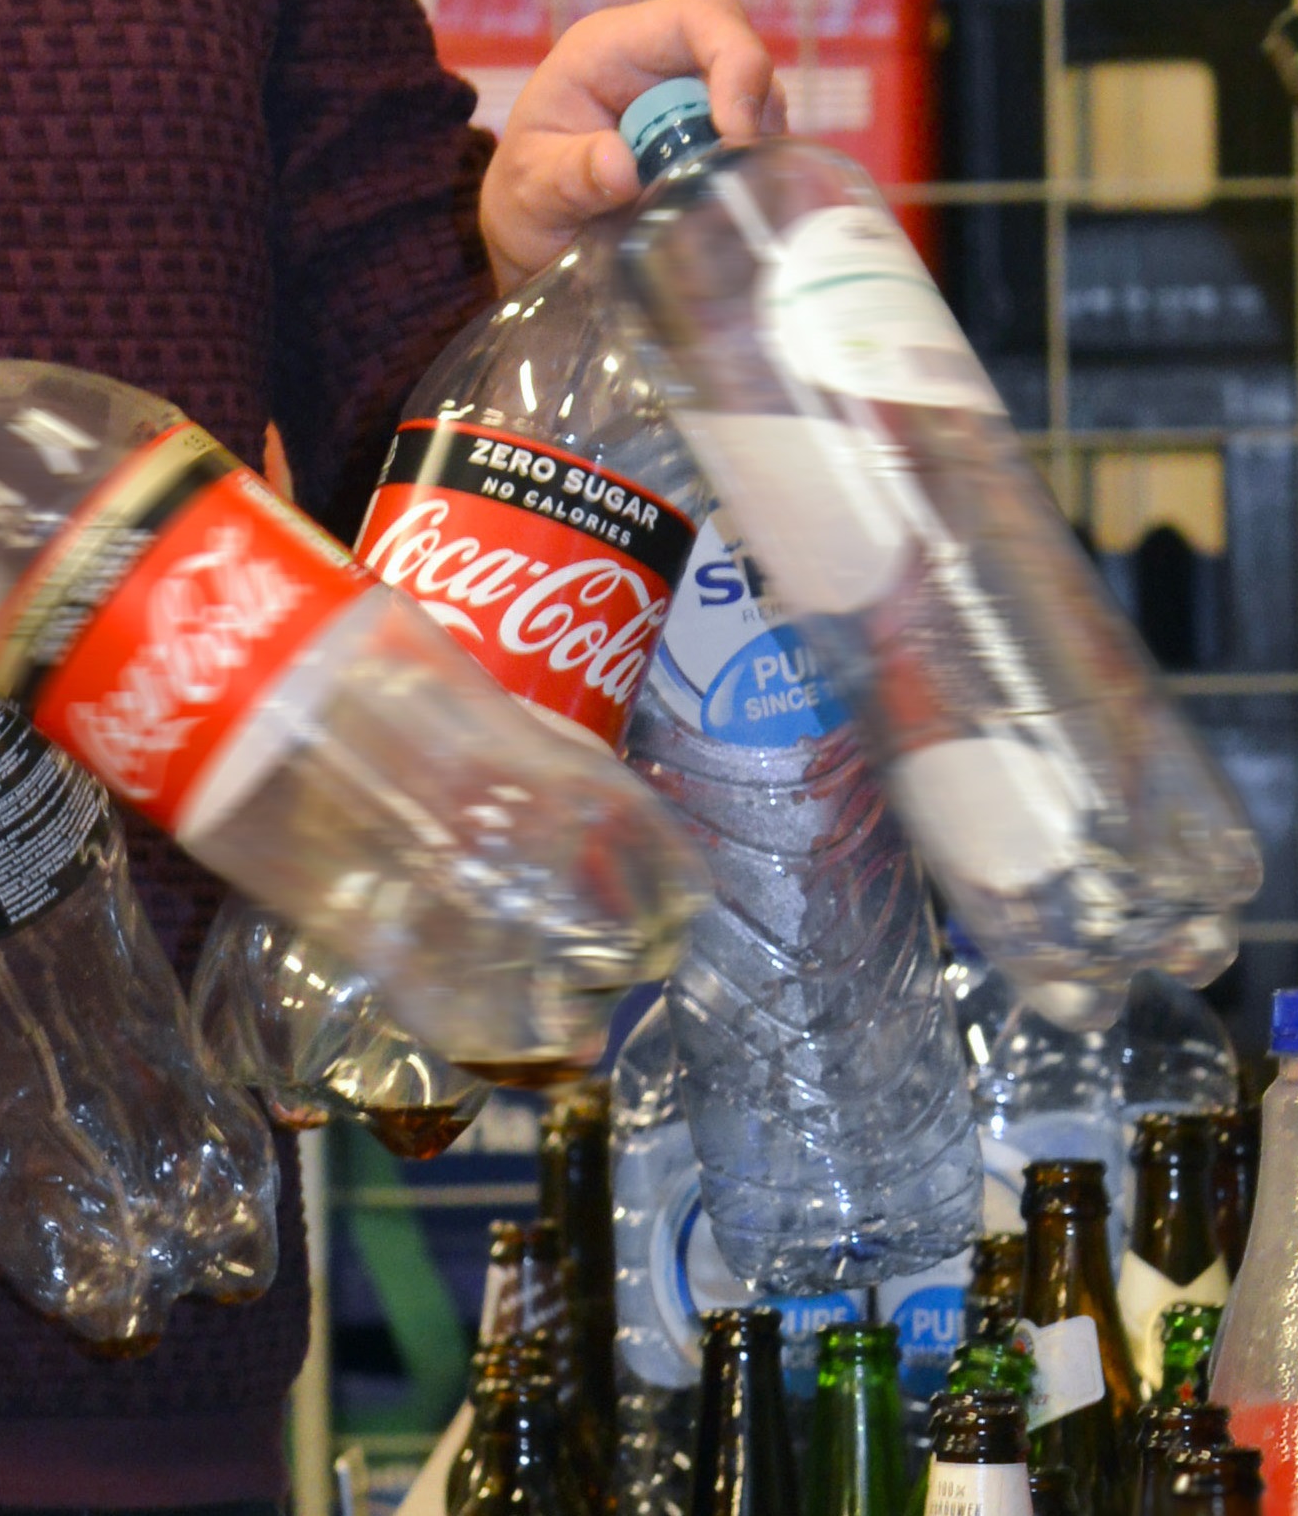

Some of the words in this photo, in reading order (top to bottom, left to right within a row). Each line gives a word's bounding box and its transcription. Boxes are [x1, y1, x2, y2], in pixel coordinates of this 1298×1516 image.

[468, 438, 557, 482] ZERO
[563, 468, 659, 532] SUGAR
[481, 476, 516, 501] NO
[522, 489, 632, 548] CALORIES
[365, 499, 668, 706] Coca-Cola
[744, 682, 820, 722] SINCE
